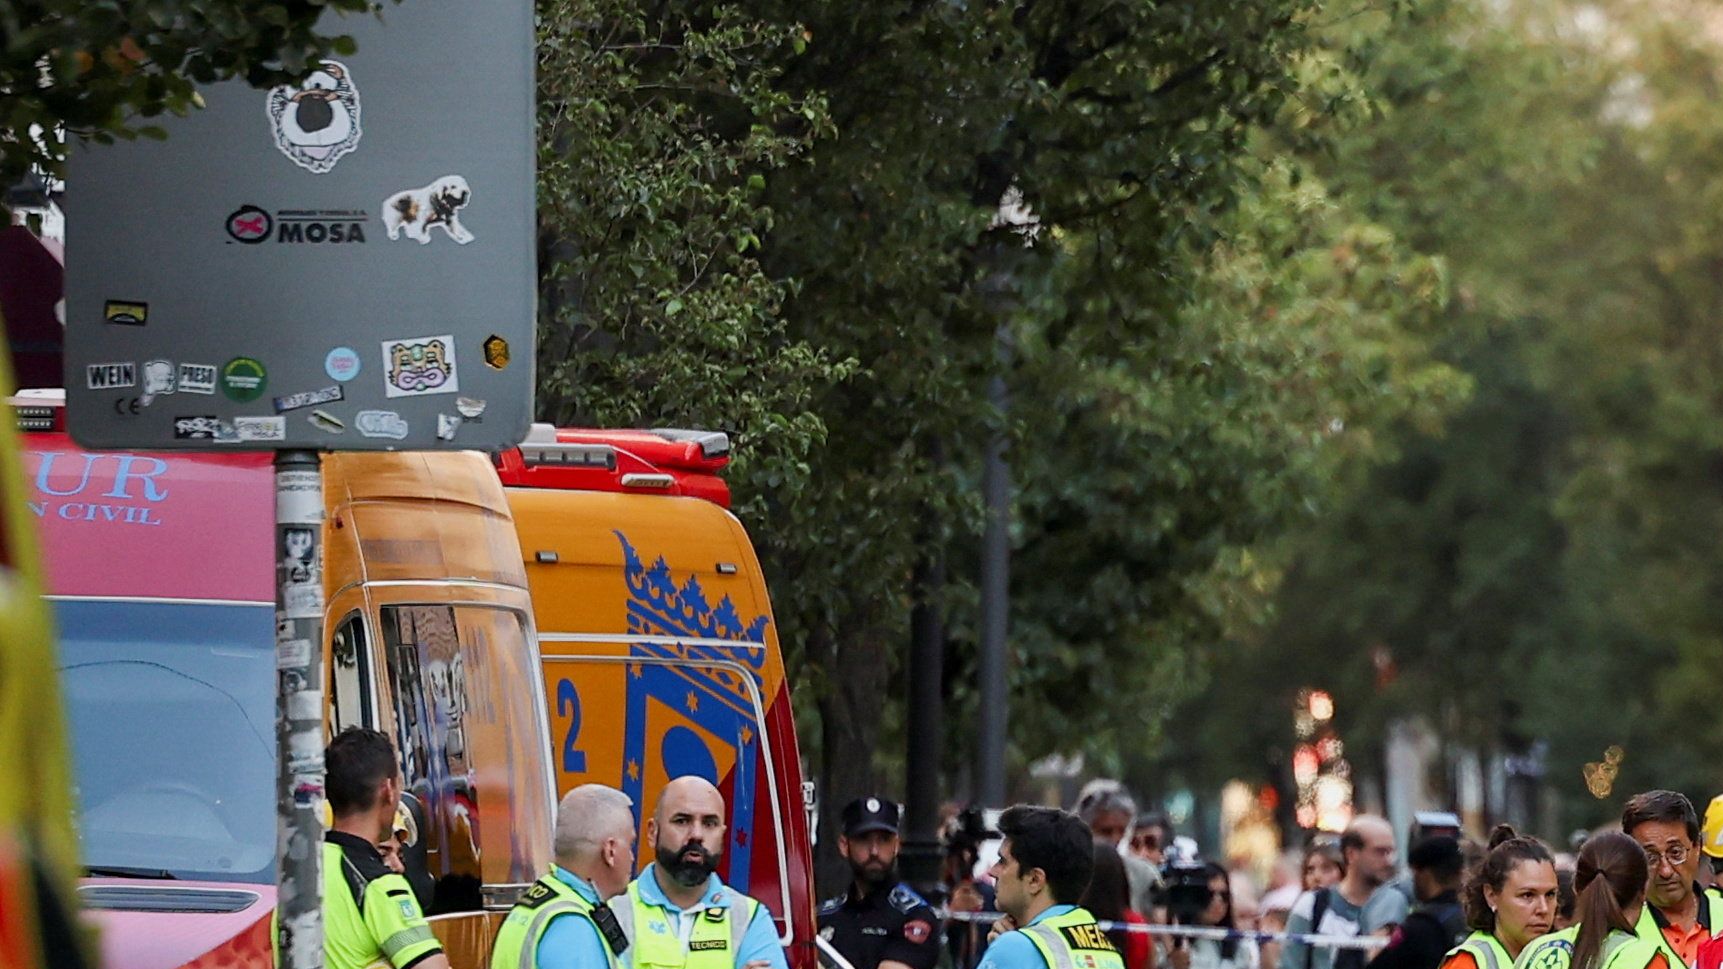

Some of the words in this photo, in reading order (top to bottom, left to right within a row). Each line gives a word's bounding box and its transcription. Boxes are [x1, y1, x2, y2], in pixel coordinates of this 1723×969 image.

[277, 223, 366, 244] MOSA
[90, 366, 134, 386] WEIN
[33, 451, 169, 502] UR
[58, 502, 161, 525] CIVIL
